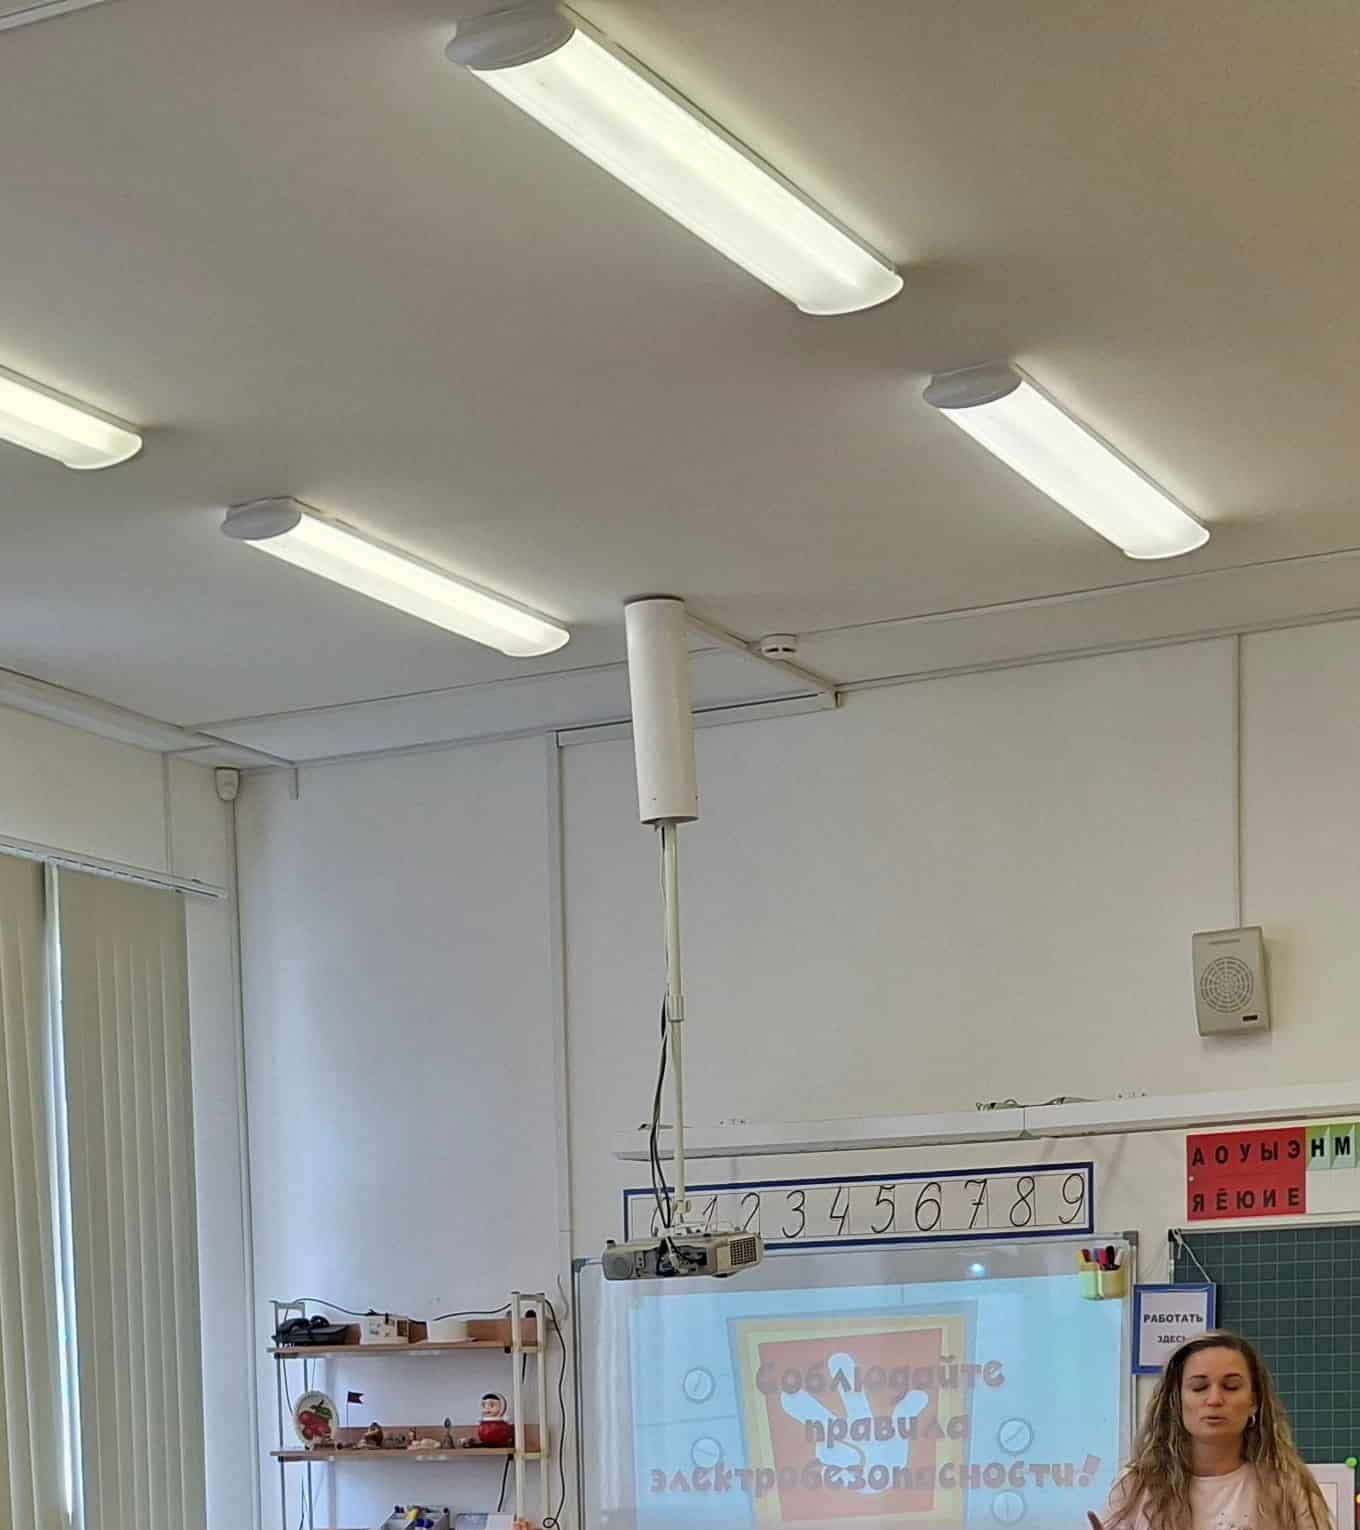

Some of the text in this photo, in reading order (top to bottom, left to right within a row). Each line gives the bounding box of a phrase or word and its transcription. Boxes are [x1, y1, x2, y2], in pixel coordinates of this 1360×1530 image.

[782, 1190, 806, 1238] 3
[829, 1186, 850, 1236] 4
[871, 1184, 895, 1233] 5
[915, 1182, 941, 1231] 6
[965, 1178, 988, 1229] 7
[1010, 1176, 1035, 1227] 8
[1058, 1173, 1085, 1224] 9
[1144, 1313, 1203, 1323] РАБОТАТЬ
[756, 1354, 1006, 1394] Соблюдайте
[805, 1415, 972, 1449] правила
[650, 1453, 1102, 1498] электробезопасности!
